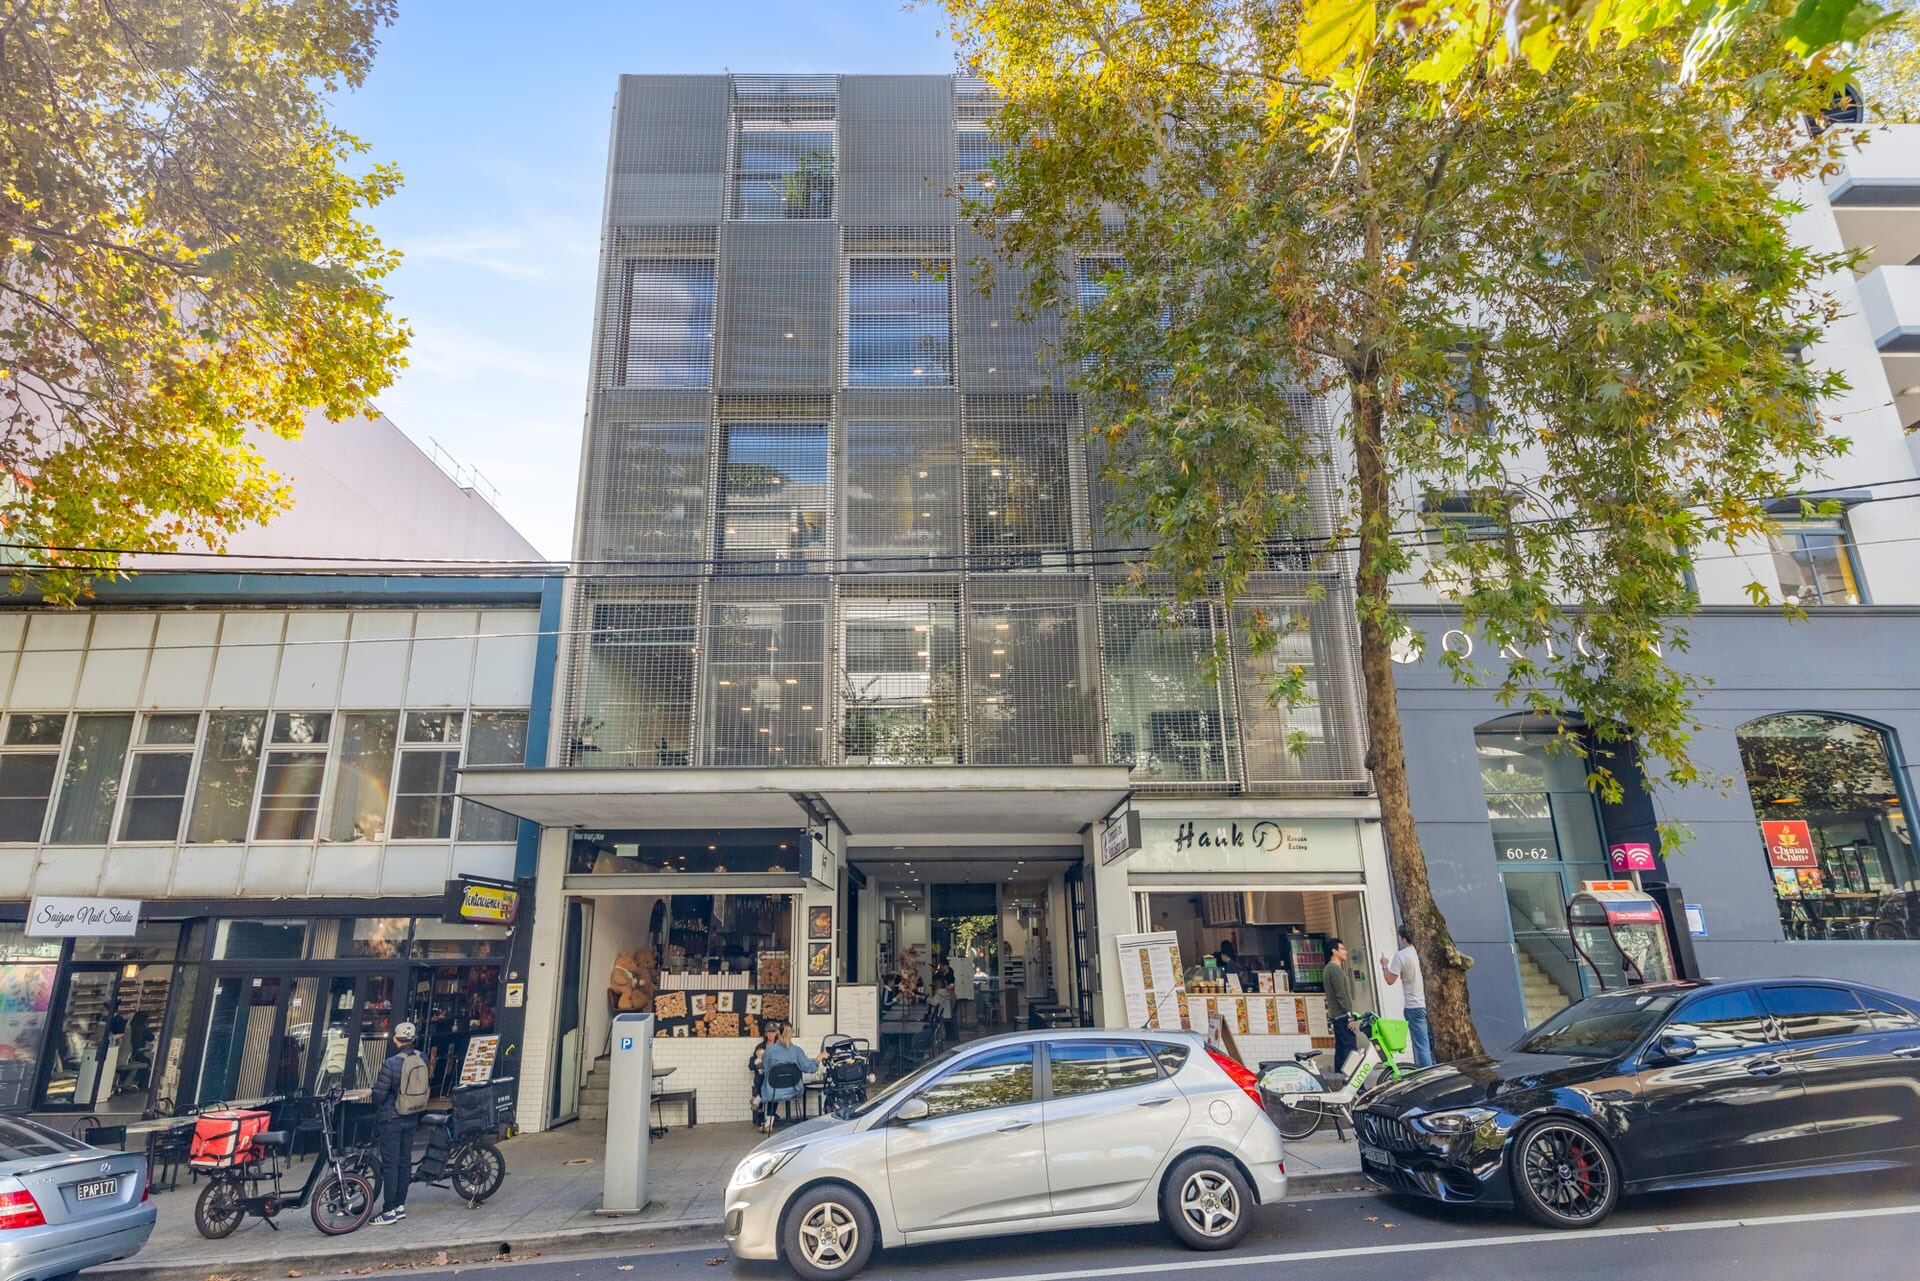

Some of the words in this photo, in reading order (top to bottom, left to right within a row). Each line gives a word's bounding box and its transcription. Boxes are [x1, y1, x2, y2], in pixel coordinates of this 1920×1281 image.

[1507, 848, 1548, 860] 60-62
[1781, 853, 1805, 861] Chim
[36, 905, 75, 928] Saigon
[77, 906, 104, 925] Nail
[103, 906, 133, 924] Studio
[622, 1038, 631, 1049] P
[1350, 1063, 1371, 1089] Lime
